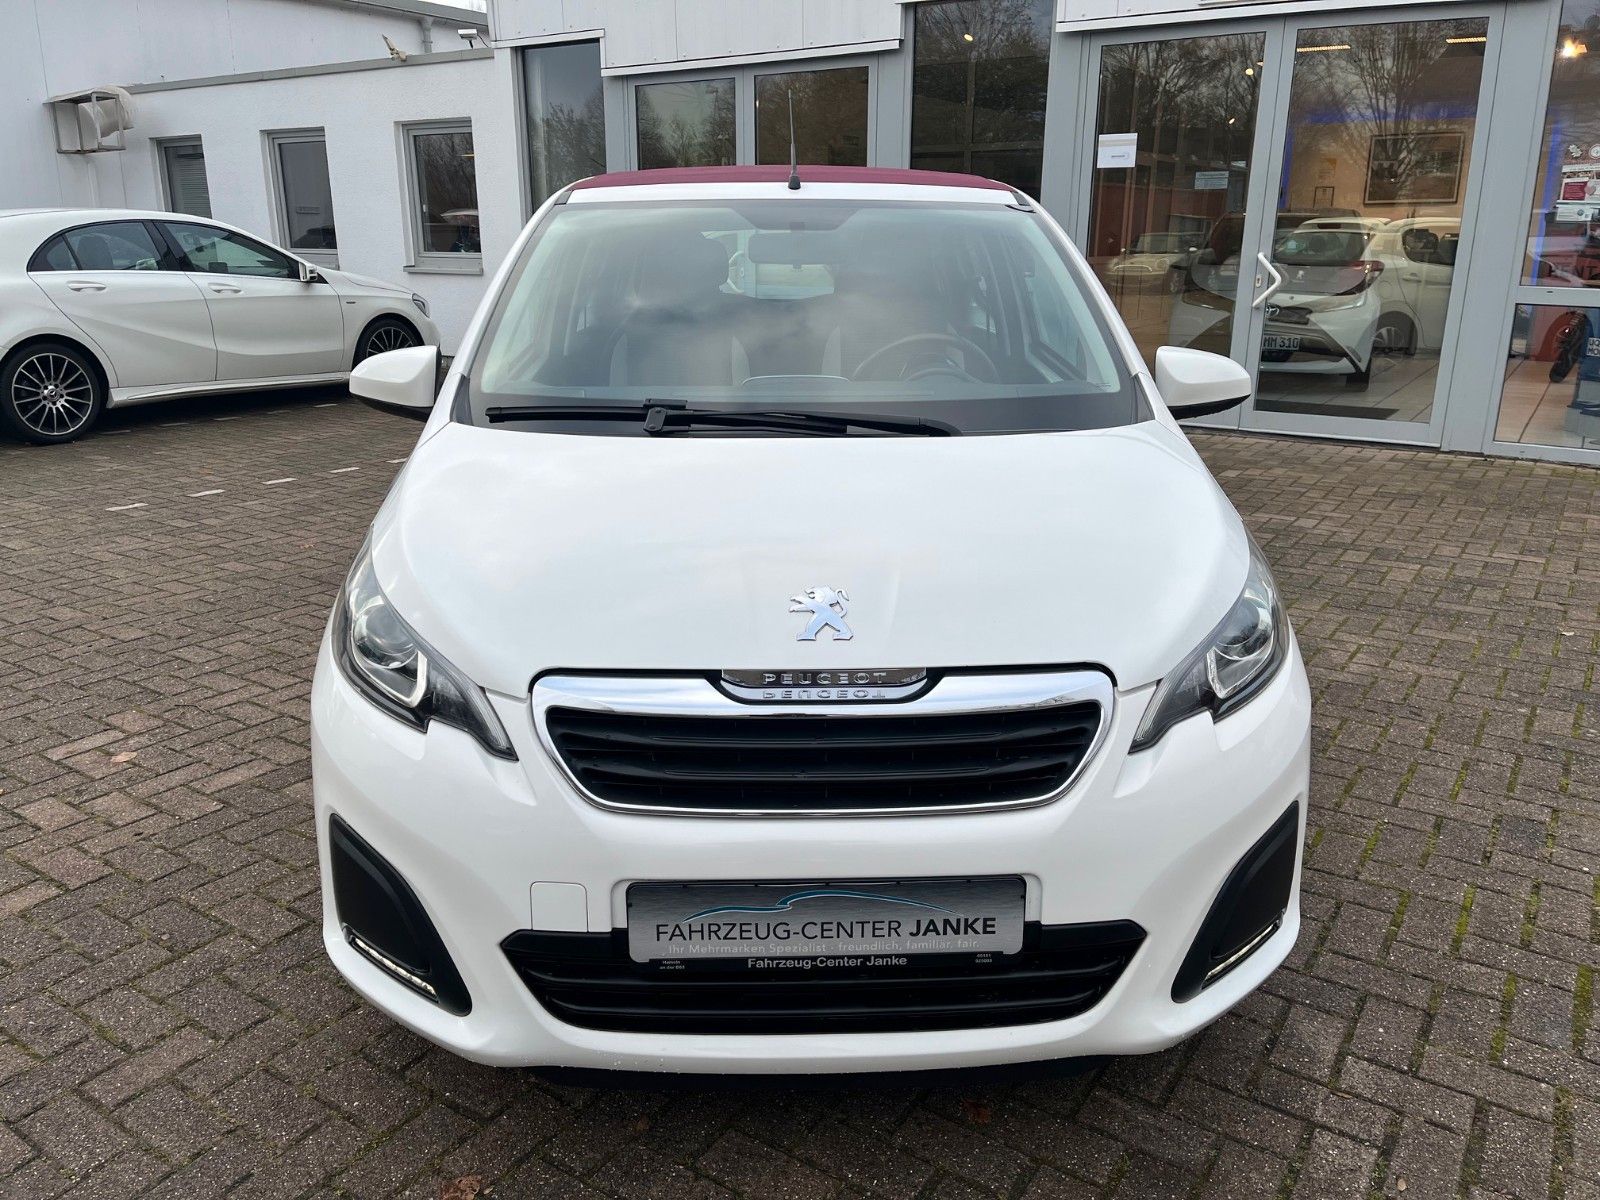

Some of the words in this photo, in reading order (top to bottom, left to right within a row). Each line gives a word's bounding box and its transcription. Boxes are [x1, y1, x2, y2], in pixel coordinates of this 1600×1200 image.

[762, 672, 887, 685] PEUGEOT
[655, 920, 902, 942] FAHRZEUG-CENTER
[908, 917, 997, 937] JANKE
[668, 944, 685, 954] Ihr
[689, 942, 766, 954] Mehrmarken
[769, 942, 827, 956] Spezialist
[747, 956, 864, 970] Fahrzeug-Center
[866, 955, 908, 967] Janke
